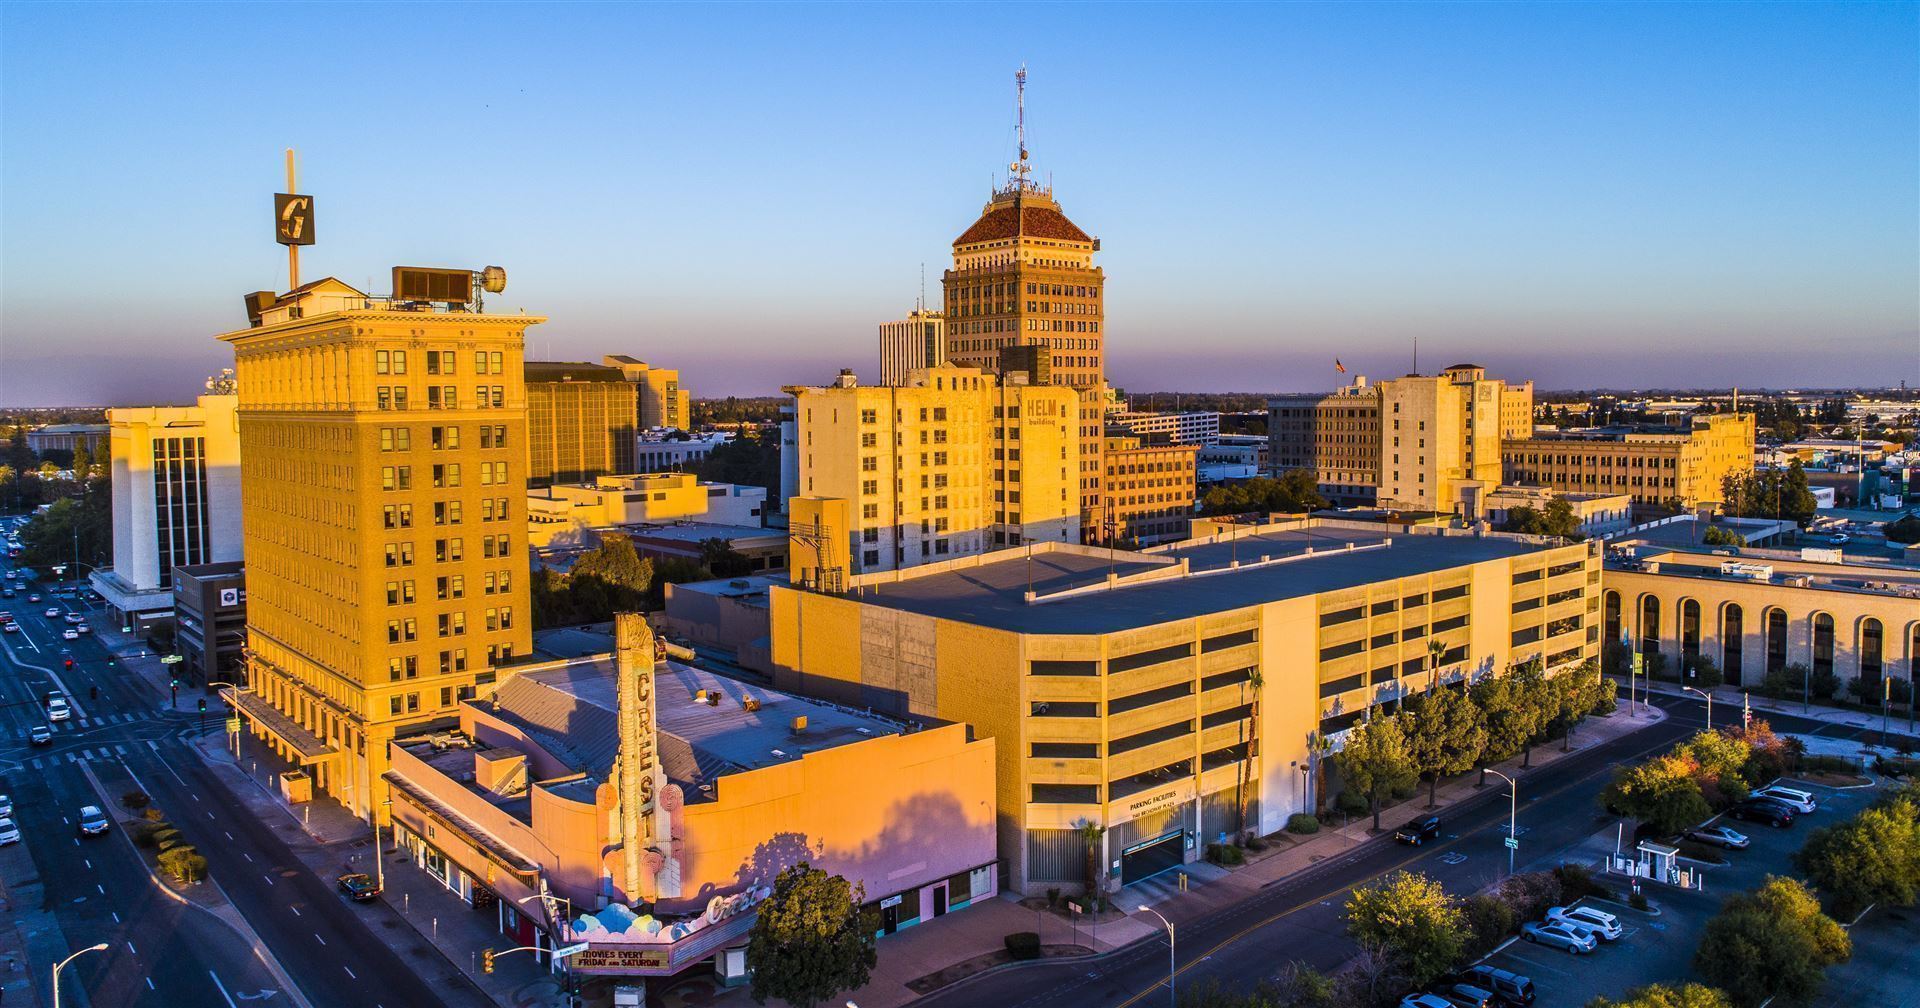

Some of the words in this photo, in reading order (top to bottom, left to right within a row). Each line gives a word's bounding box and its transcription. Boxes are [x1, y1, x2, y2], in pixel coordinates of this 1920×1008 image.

[281, 197, 308, 239] G
[1027, 399, 1057, 416] HELM
[1028, 418, 1056, 427] building
[637, 672, 654, 839] CREST
[1130, 798, 1152, 811] PARKING
[1152, 790, 1177, 804] FACILITIES
[578, 959, 607, 967] FRIDAY
[621, 959, 660, 967] SATURDAY
[582, 951, 615, 959] MOVIES
[618, 951, 644, 959] EVERY
